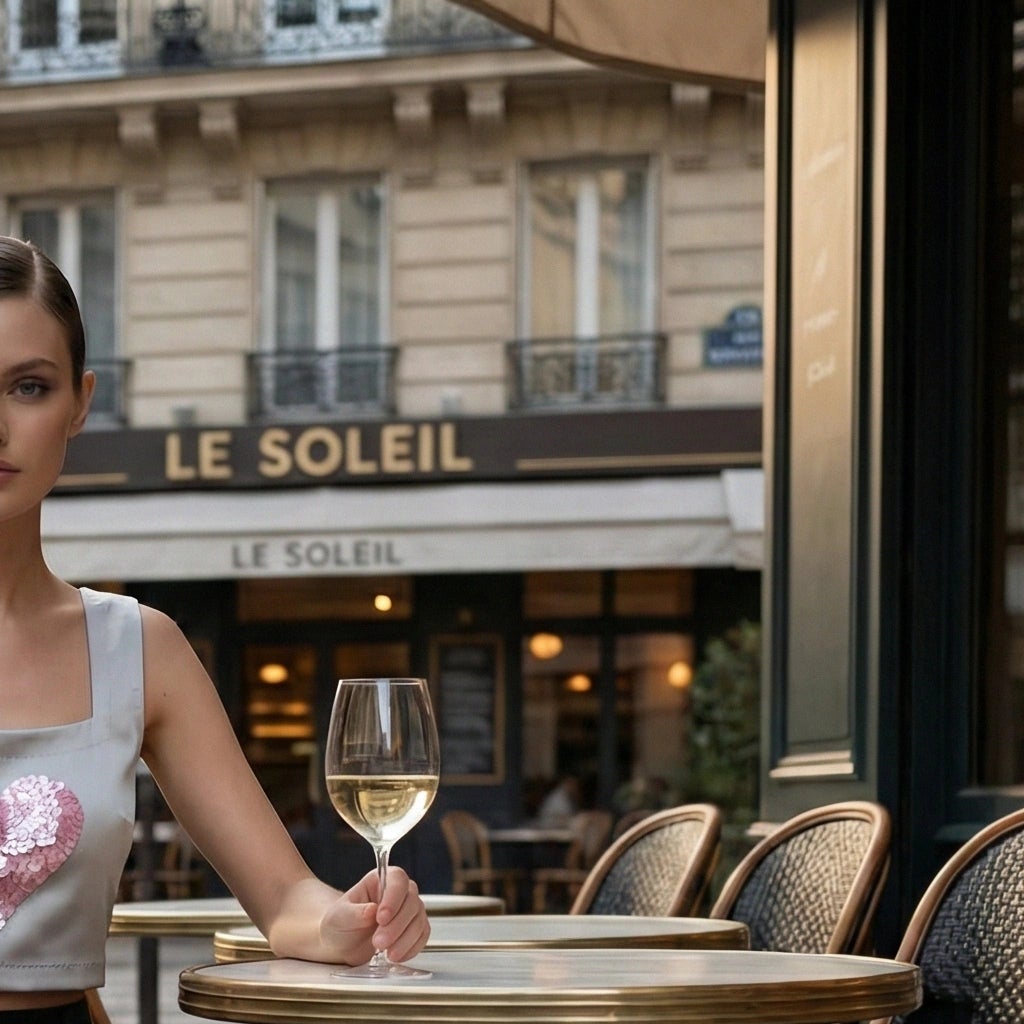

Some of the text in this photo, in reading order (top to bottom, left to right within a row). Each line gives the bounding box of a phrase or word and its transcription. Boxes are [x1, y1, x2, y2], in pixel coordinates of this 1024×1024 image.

[165, 422, 473, 480] LE SOLEIL
[231, 540, 403, 569] LE SOLEIL
